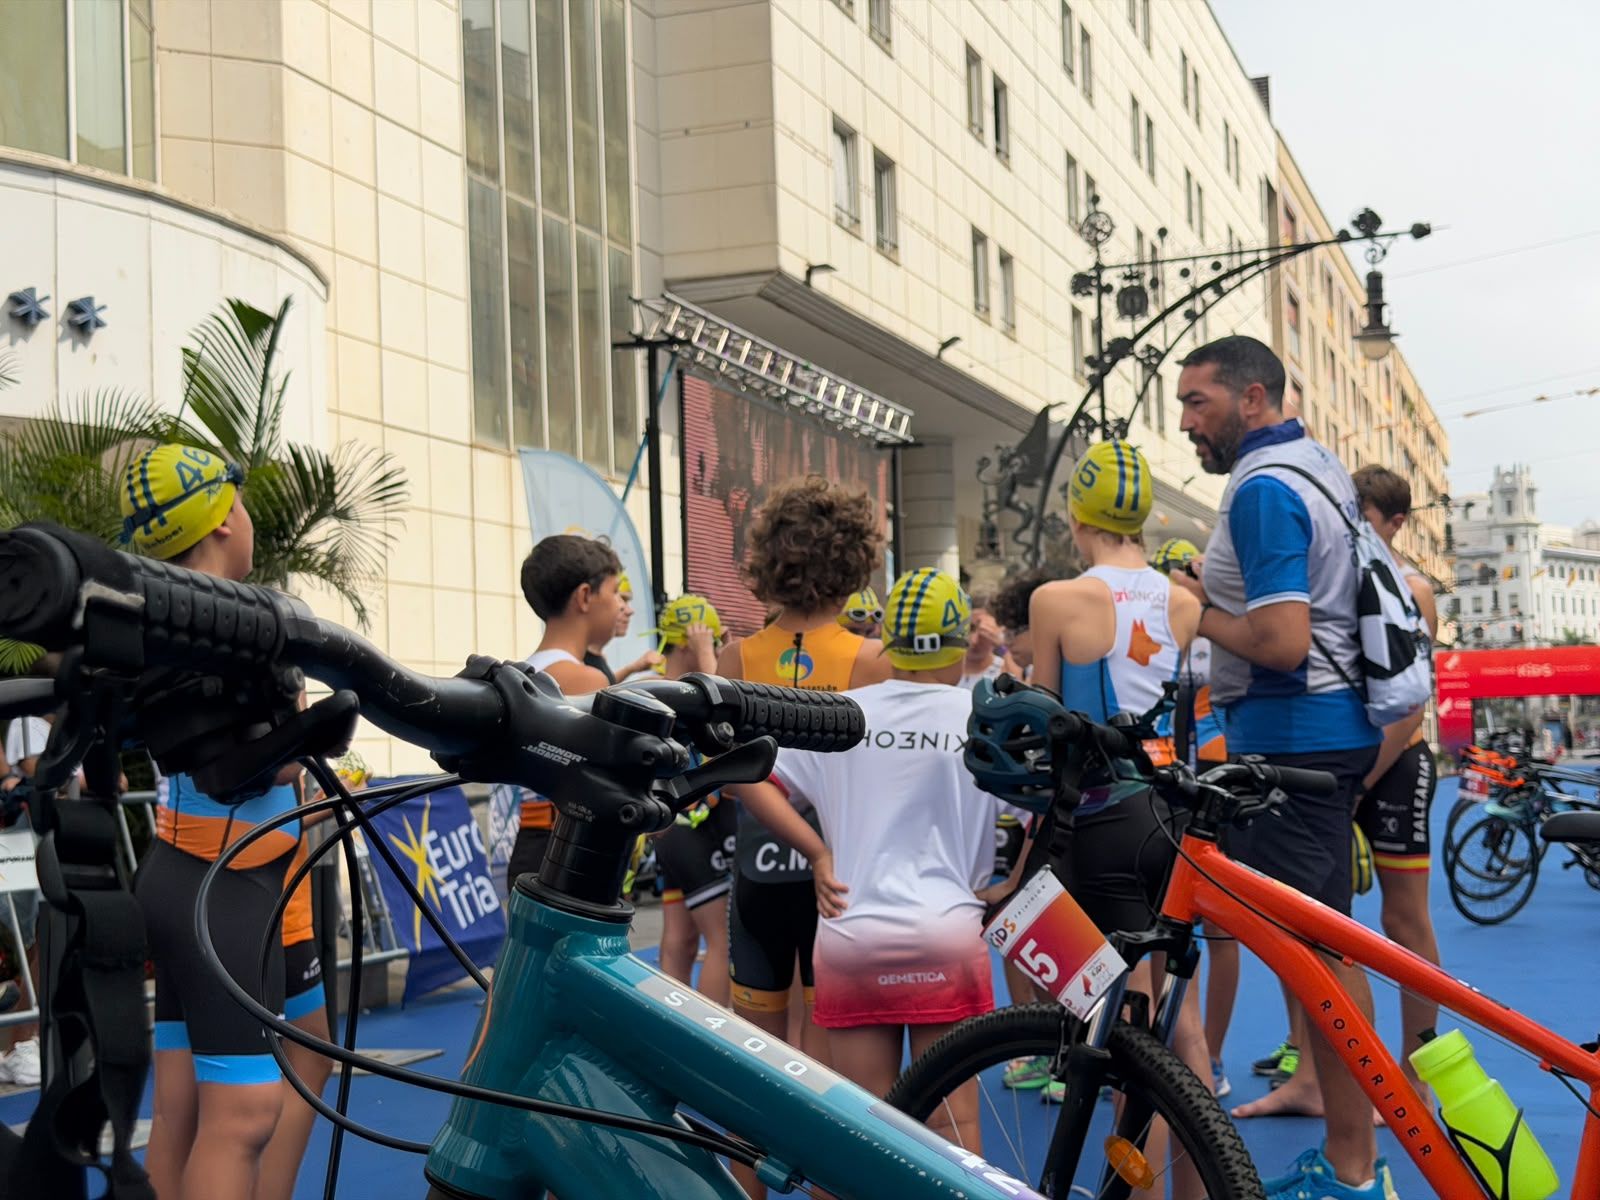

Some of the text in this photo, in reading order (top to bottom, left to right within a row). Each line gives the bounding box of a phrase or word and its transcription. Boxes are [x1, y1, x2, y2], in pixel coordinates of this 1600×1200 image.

[674, 604, 706, 625] 57
[863, 729, 968, 753] HO3NIX
[439, 871, 500, 930] Tria
[1013, 938, 1059, 992] 5
[1320, 999, 1433, 1157] ROCKRIDER
